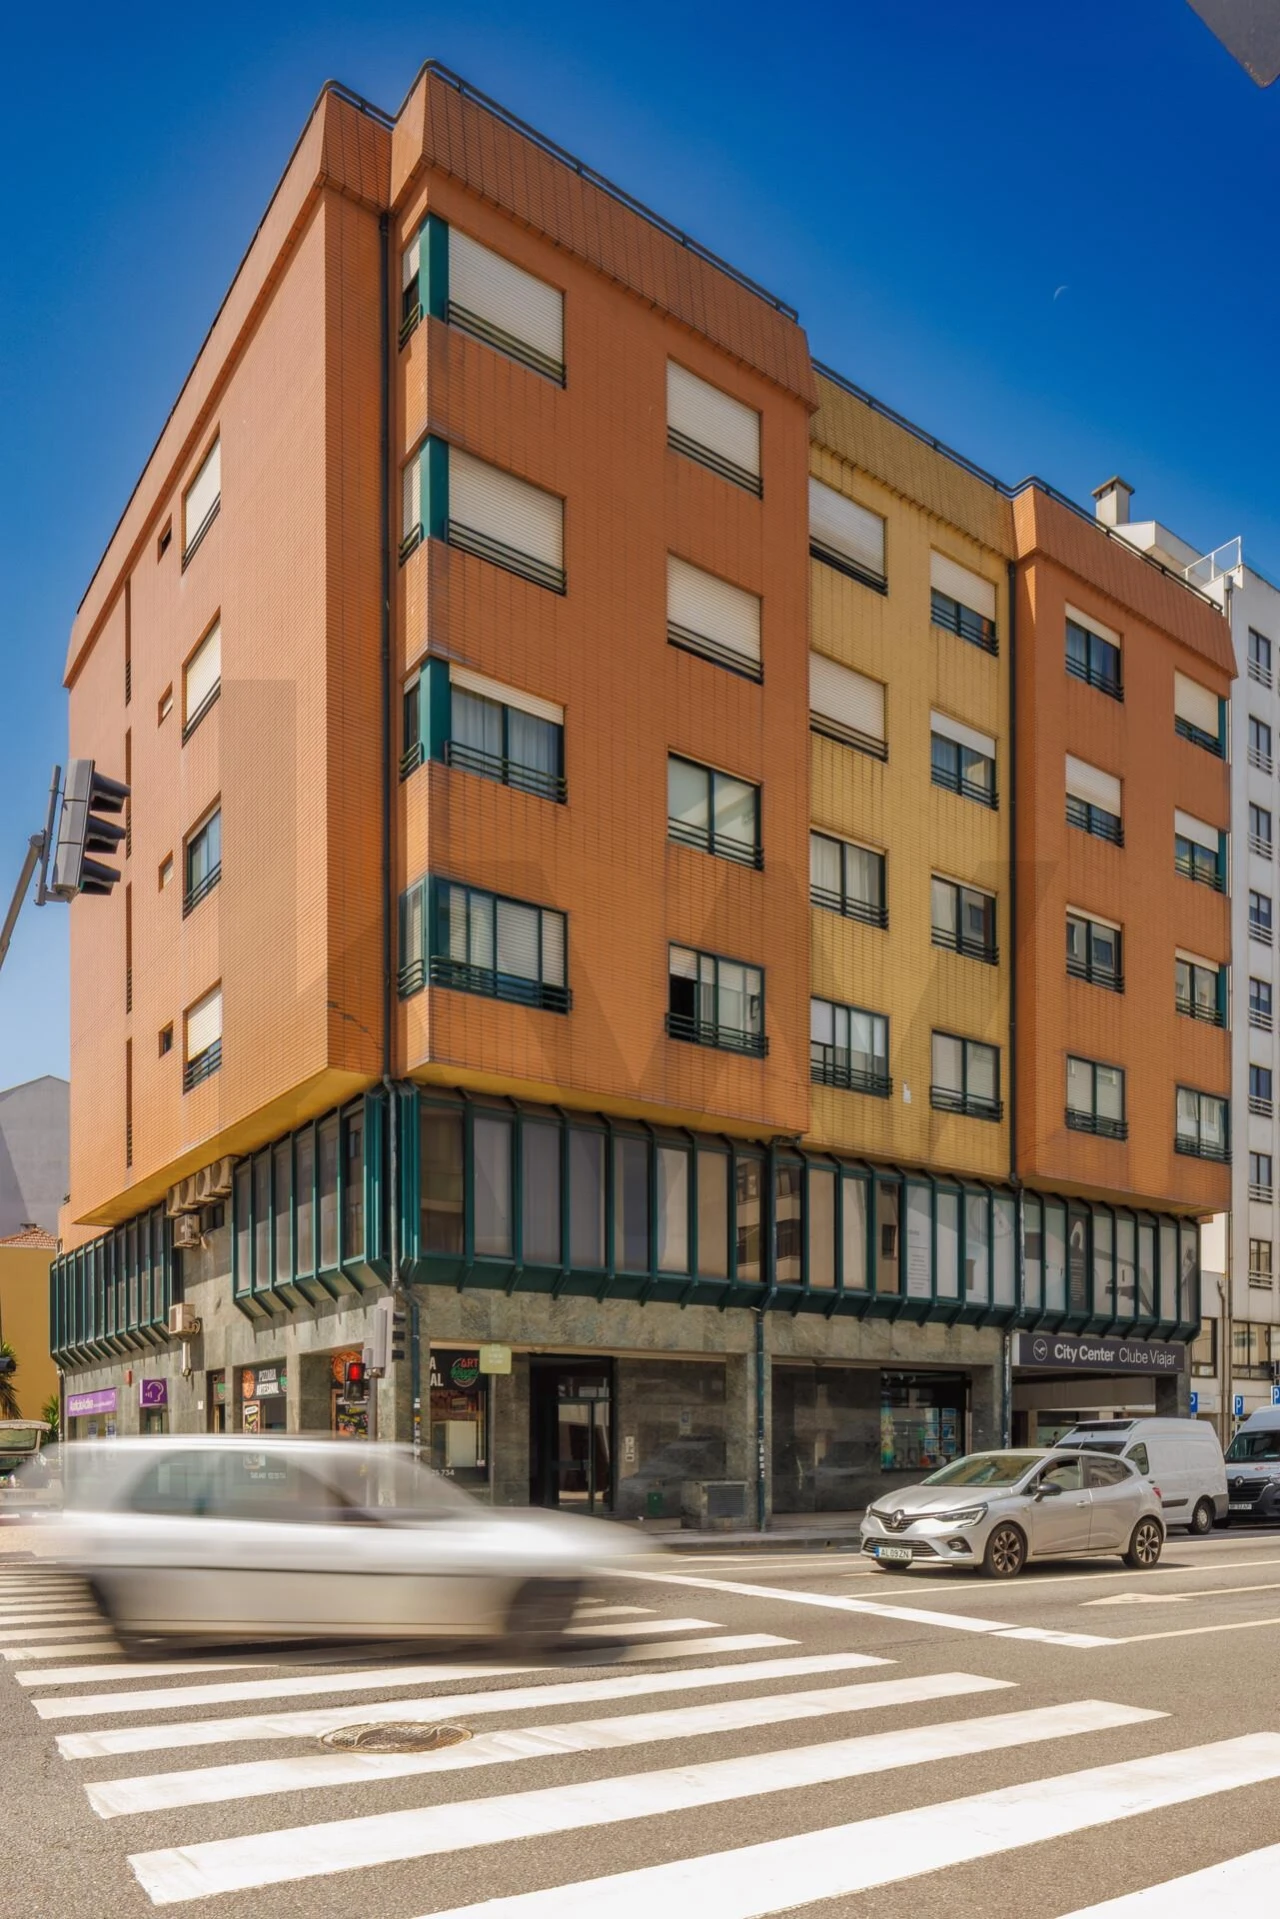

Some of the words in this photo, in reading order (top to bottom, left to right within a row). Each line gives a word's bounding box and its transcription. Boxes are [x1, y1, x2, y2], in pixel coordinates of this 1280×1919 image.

[1054, 1343, 1078, 1363] City
[1079, 1345, 1115, 1362] Center
[1119, 1347, 1149, 1364] Clube
[1149, 1349, 1176, 1368] Viajar
[1236, 1397, 1242, 1413] P
